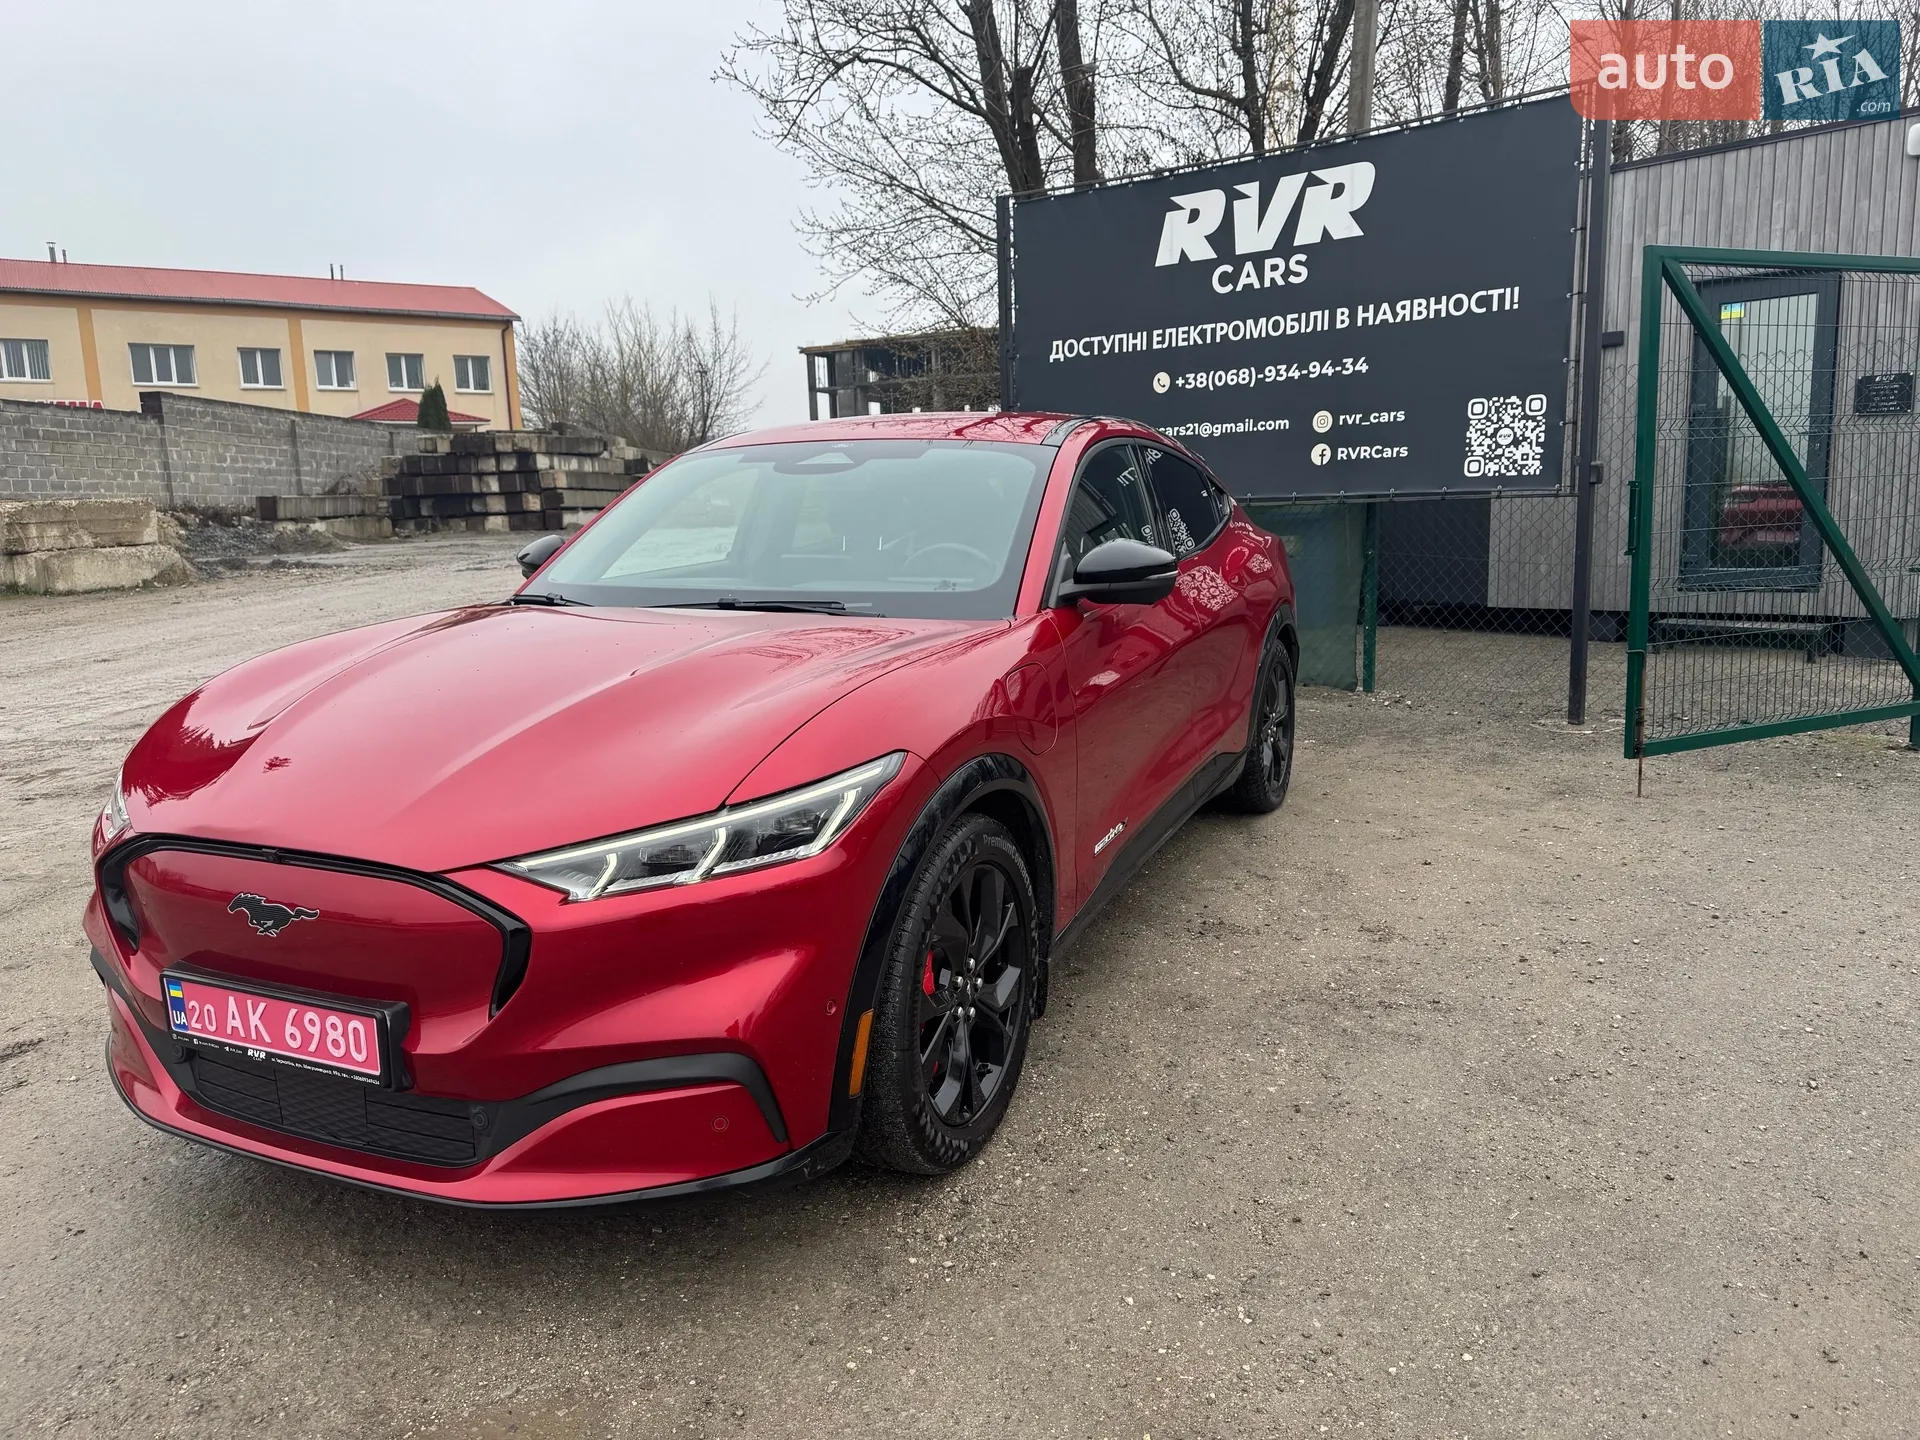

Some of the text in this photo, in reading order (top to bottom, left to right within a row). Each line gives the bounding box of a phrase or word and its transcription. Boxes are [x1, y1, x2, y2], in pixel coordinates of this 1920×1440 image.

[1155, 161, 1376, 268] RVR
[1211, 253, 1309, 294] CARS
[1049, 286, 1520, 363] ДОСТУПНІ ЕЛЕКТРОМОБІЛІ В НАЯВНОСТІ!
[1175, 356, 1369, 391] +38(068)-934-94-34
[1339, 410, 1406, 426] rvr_cars
[1337, 445, 1409, 461] RVRCars
[173, 1009, 188, 1026] UA
[187, 996, 368, 1063] 20 AK 6980
[247, 1048, 266, 1060] RVR
